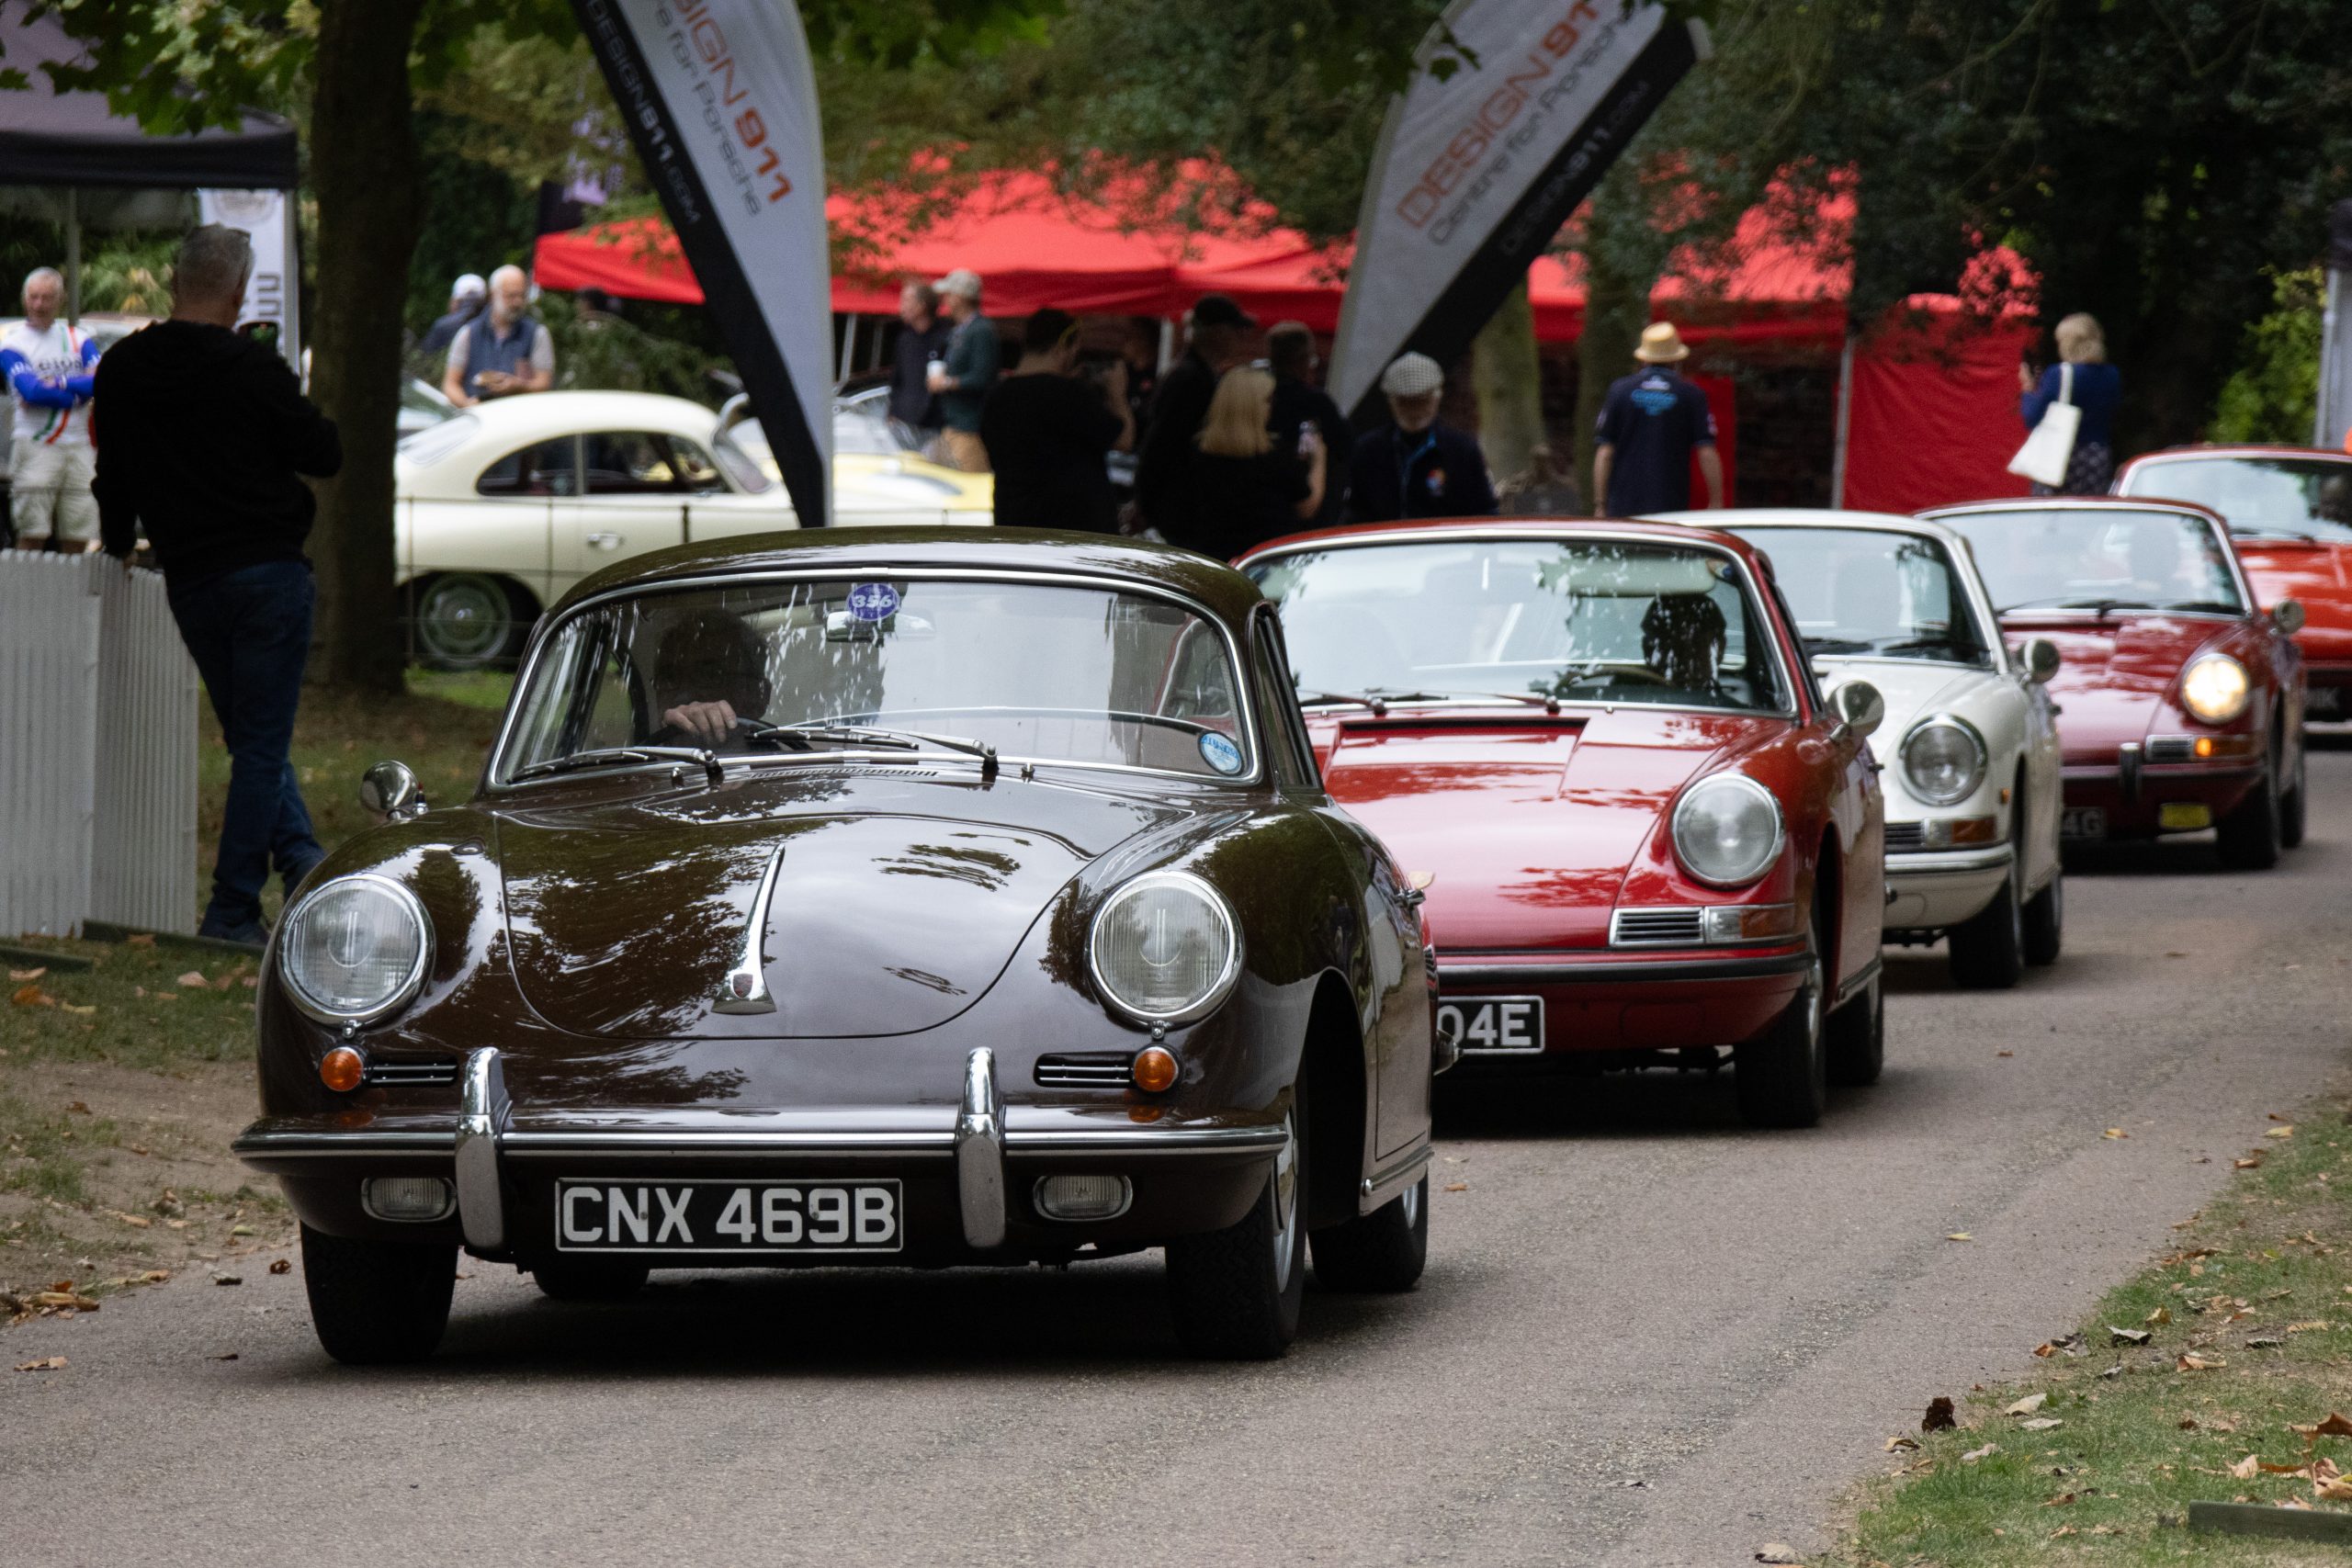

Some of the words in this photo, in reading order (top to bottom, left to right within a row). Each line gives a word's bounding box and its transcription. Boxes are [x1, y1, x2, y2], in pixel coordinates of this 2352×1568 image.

[667, 29, 699, 78] for
[693, 80, 762, 217] Porsche
[1427, 152, 1510, 245] Centre
[1506, 111, 1542, 153] for
[852, 594, 893, 608] 356
[563, 1187, 694, 1243] CNX
[716, 1188, 896, 1243] 469B
